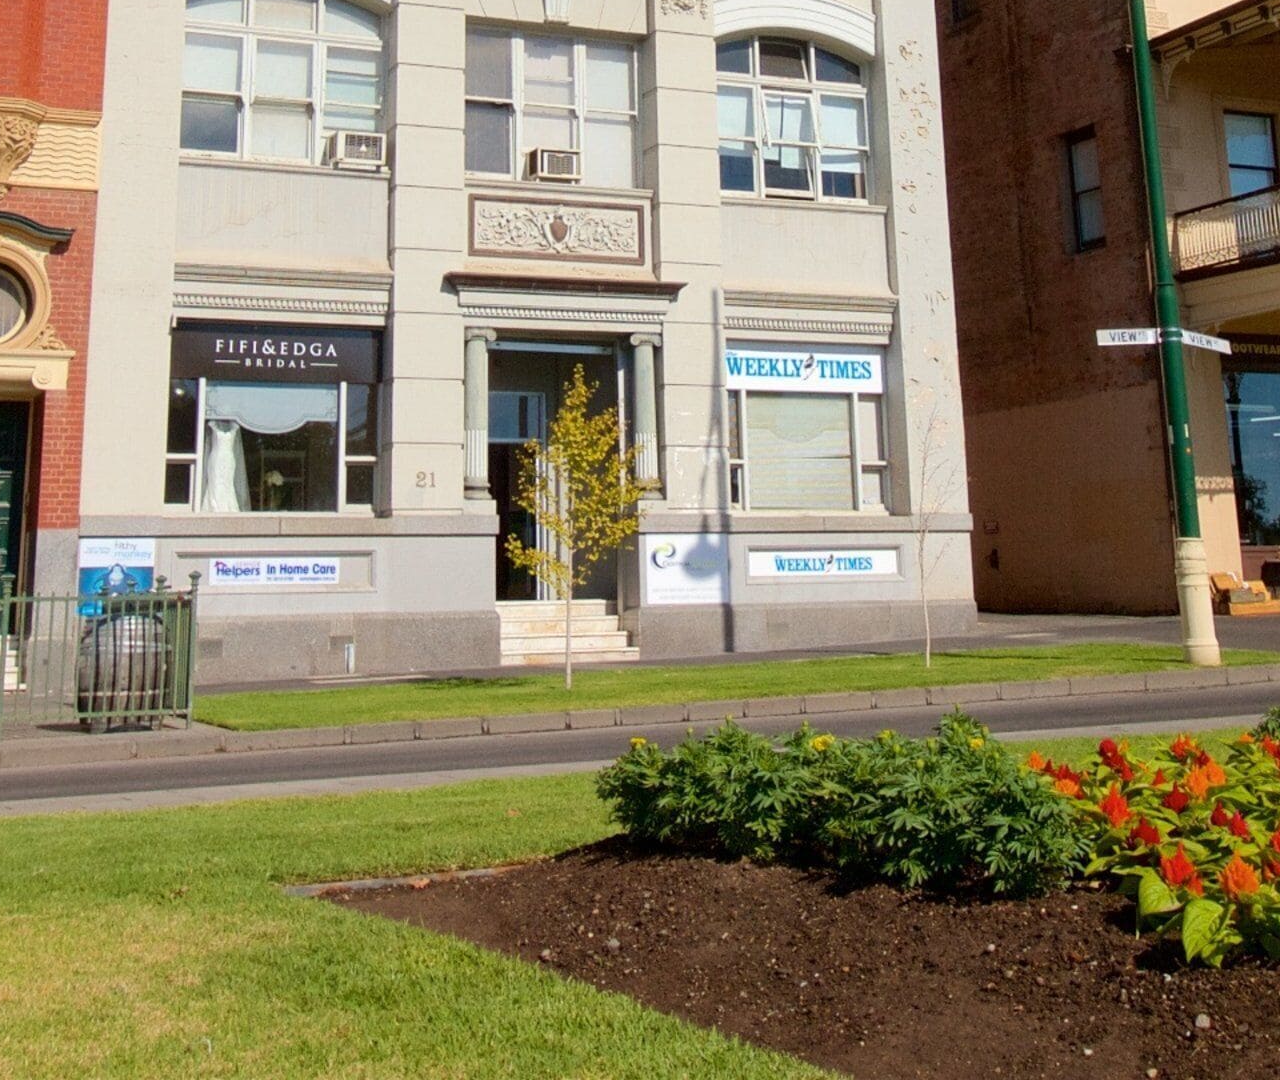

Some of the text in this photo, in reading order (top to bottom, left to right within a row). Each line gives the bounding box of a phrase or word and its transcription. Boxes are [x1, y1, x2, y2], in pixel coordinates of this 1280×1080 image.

[1109, 331, 1137, 343] VIEW
[1189, 333, 1213, 348] VIEW
[215, 338, 337, 357] FIFI&EDGA
[245, 358, 306, 369] BRIDAL
[726, 357, 872, 380] WEEKLY TIMES
[415, 471, 436, 488] 21
[216, 565, 261, 578] Helpers
[267, 563, 336, 575] In Home Care
[775, 557, 873, 572] WEEKLY TIMES
